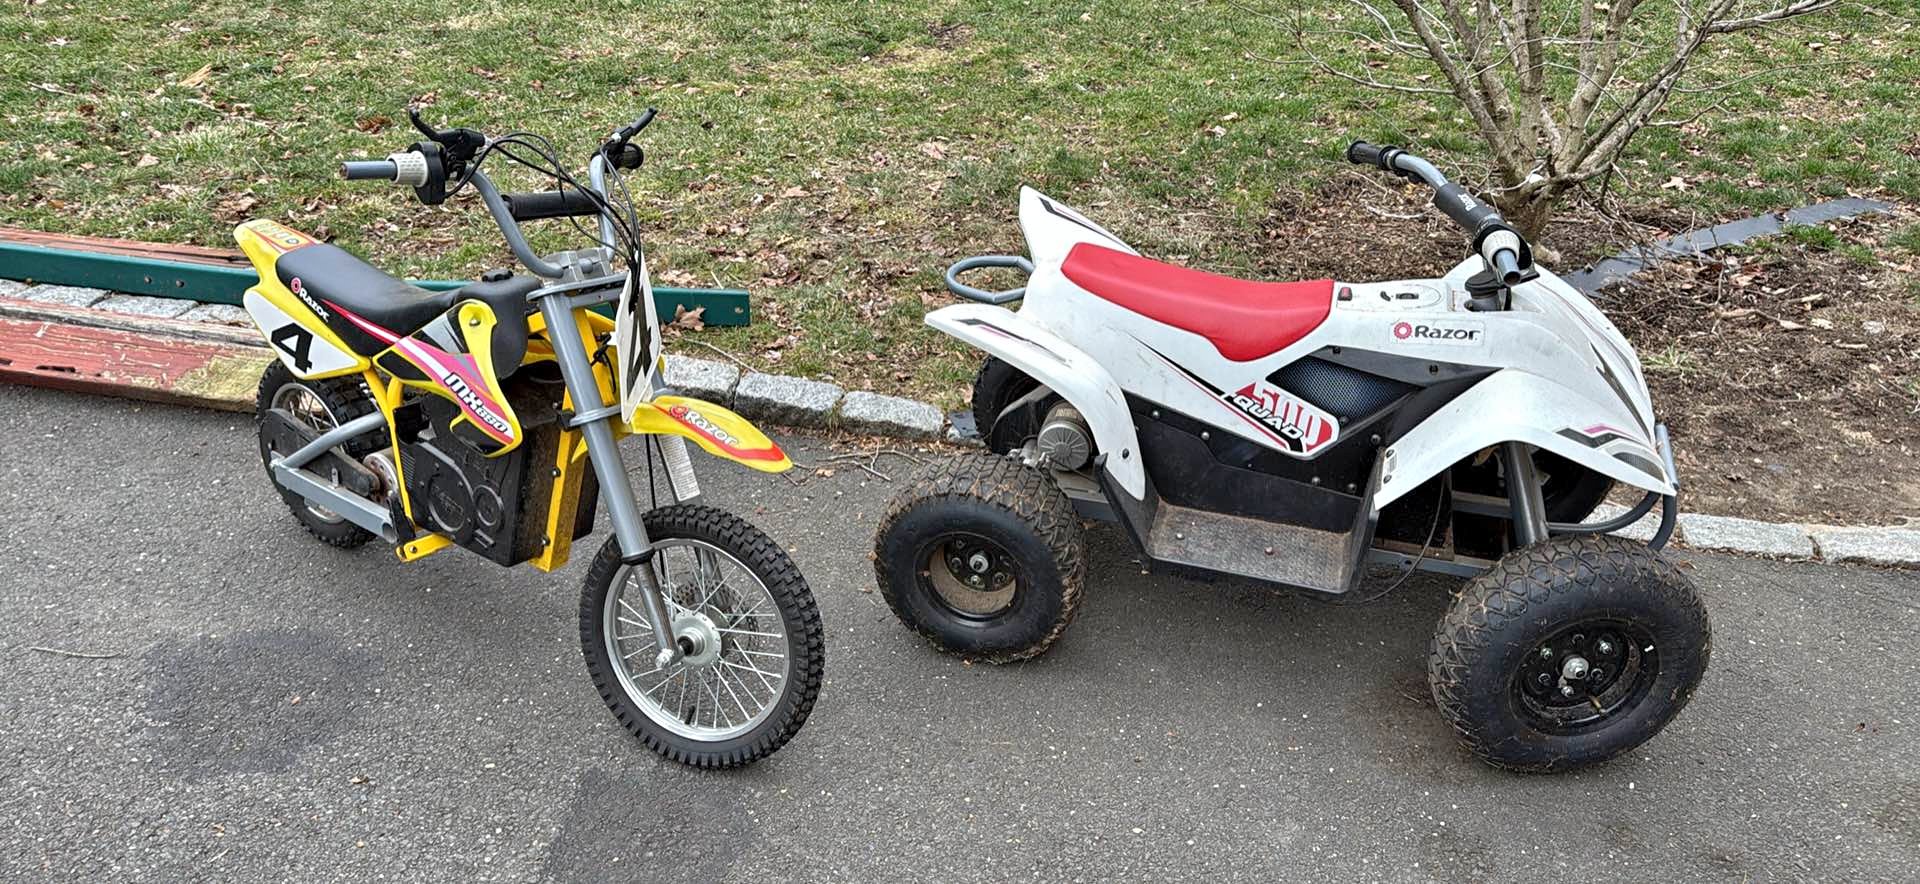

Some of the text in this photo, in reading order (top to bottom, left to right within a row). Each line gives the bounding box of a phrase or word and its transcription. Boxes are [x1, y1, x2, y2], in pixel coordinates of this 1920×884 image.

[270, 322, 313, 375] 4
[626, 285, 652, 399] 4
[1414, 325, 1481, 341] Razor
[685, 410, 739, 446] Razor
[1232, 394, 1305, 440] QUAD
[1252, 381, 1323, 447] 500
